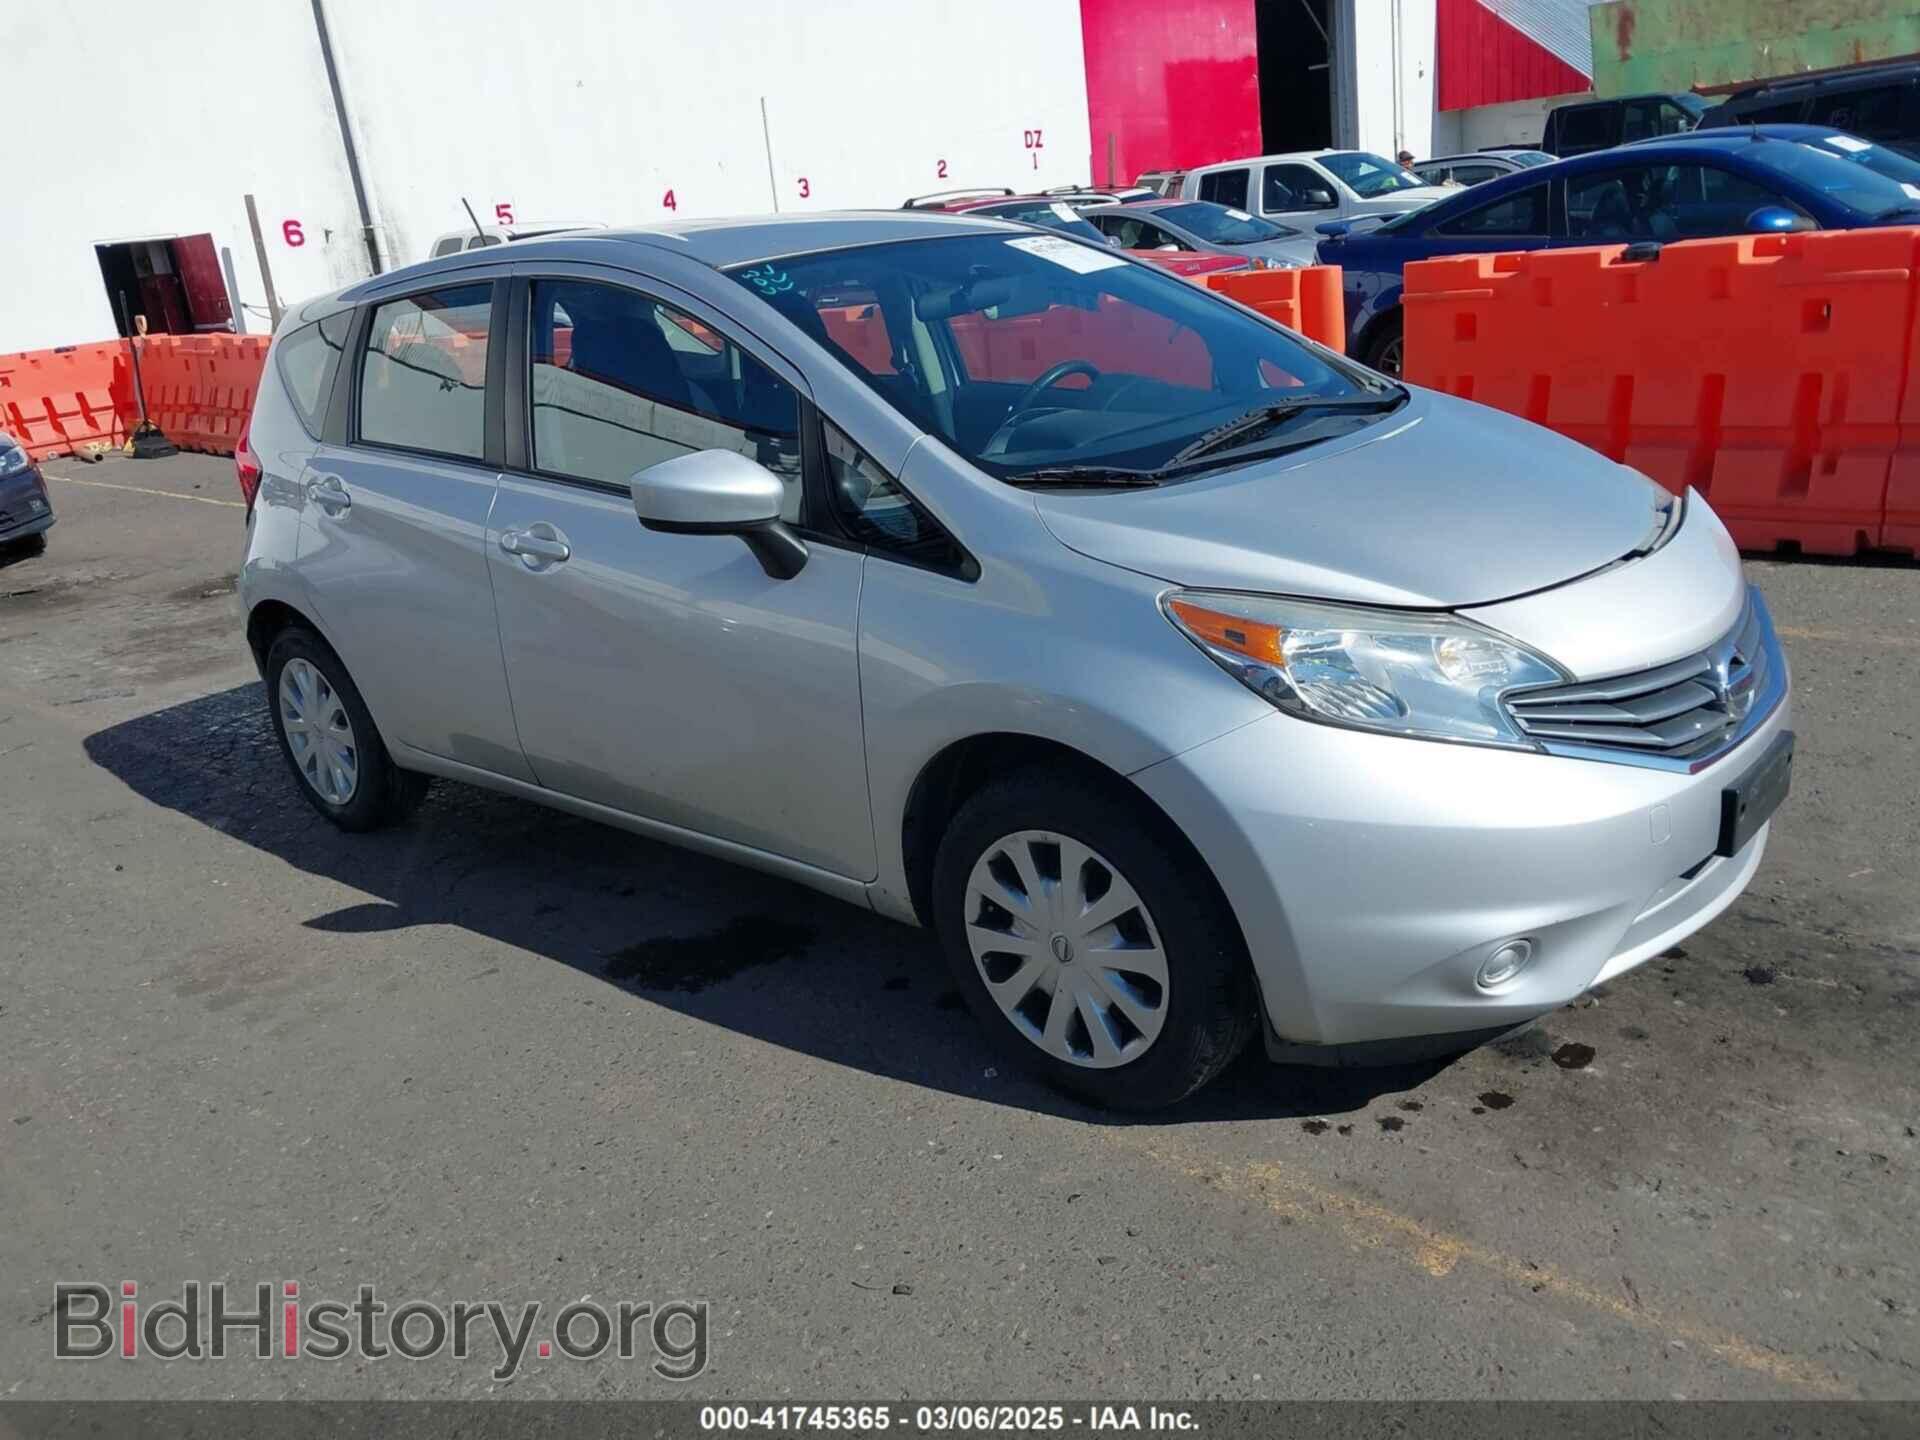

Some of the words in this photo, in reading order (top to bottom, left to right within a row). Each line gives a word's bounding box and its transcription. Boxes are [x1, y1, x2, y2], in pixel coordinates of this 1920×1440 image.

[936, 159, 949, 179] 2
[797, 177, 811, 199] 3
[662, 188, 678, 212] 4
[495, 203, 514, 226] 5
[281, 219, 306, 248] 6
